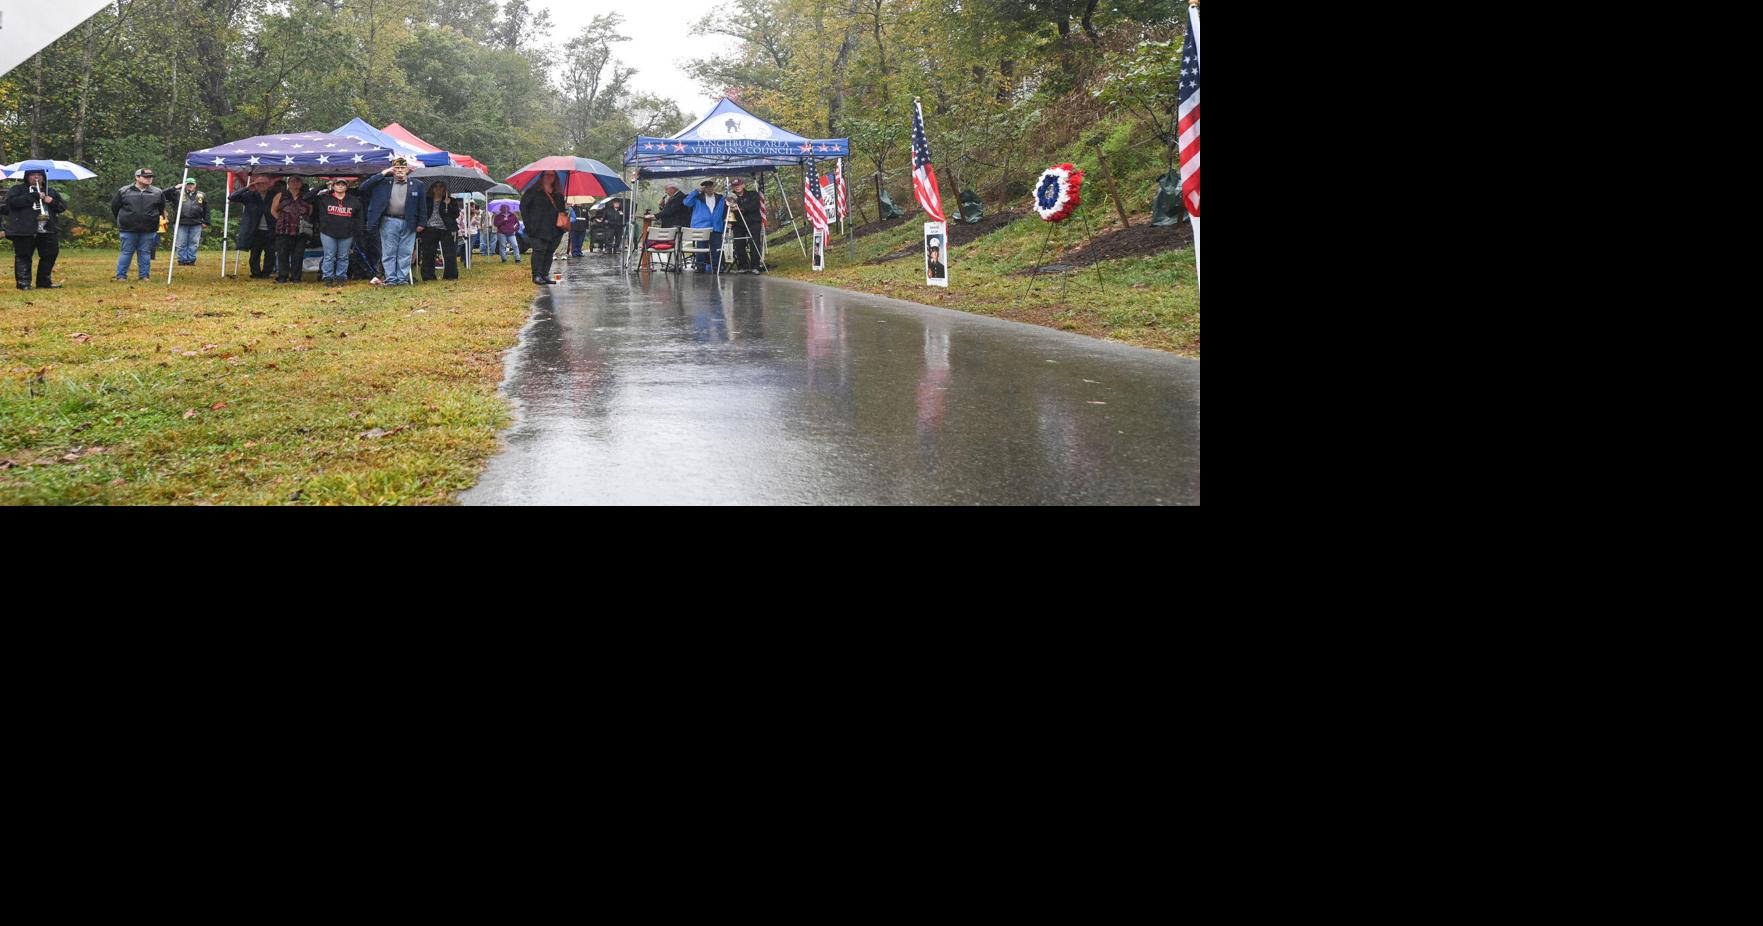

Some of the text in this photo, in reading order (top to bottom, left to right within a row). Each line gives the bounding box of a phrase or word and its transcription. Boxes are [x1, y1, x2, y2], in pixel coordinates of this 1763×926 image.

[691, 146, 795, 155] VETERANS COUNCIL
[327, 205, 353, 214] CATHOLIC
